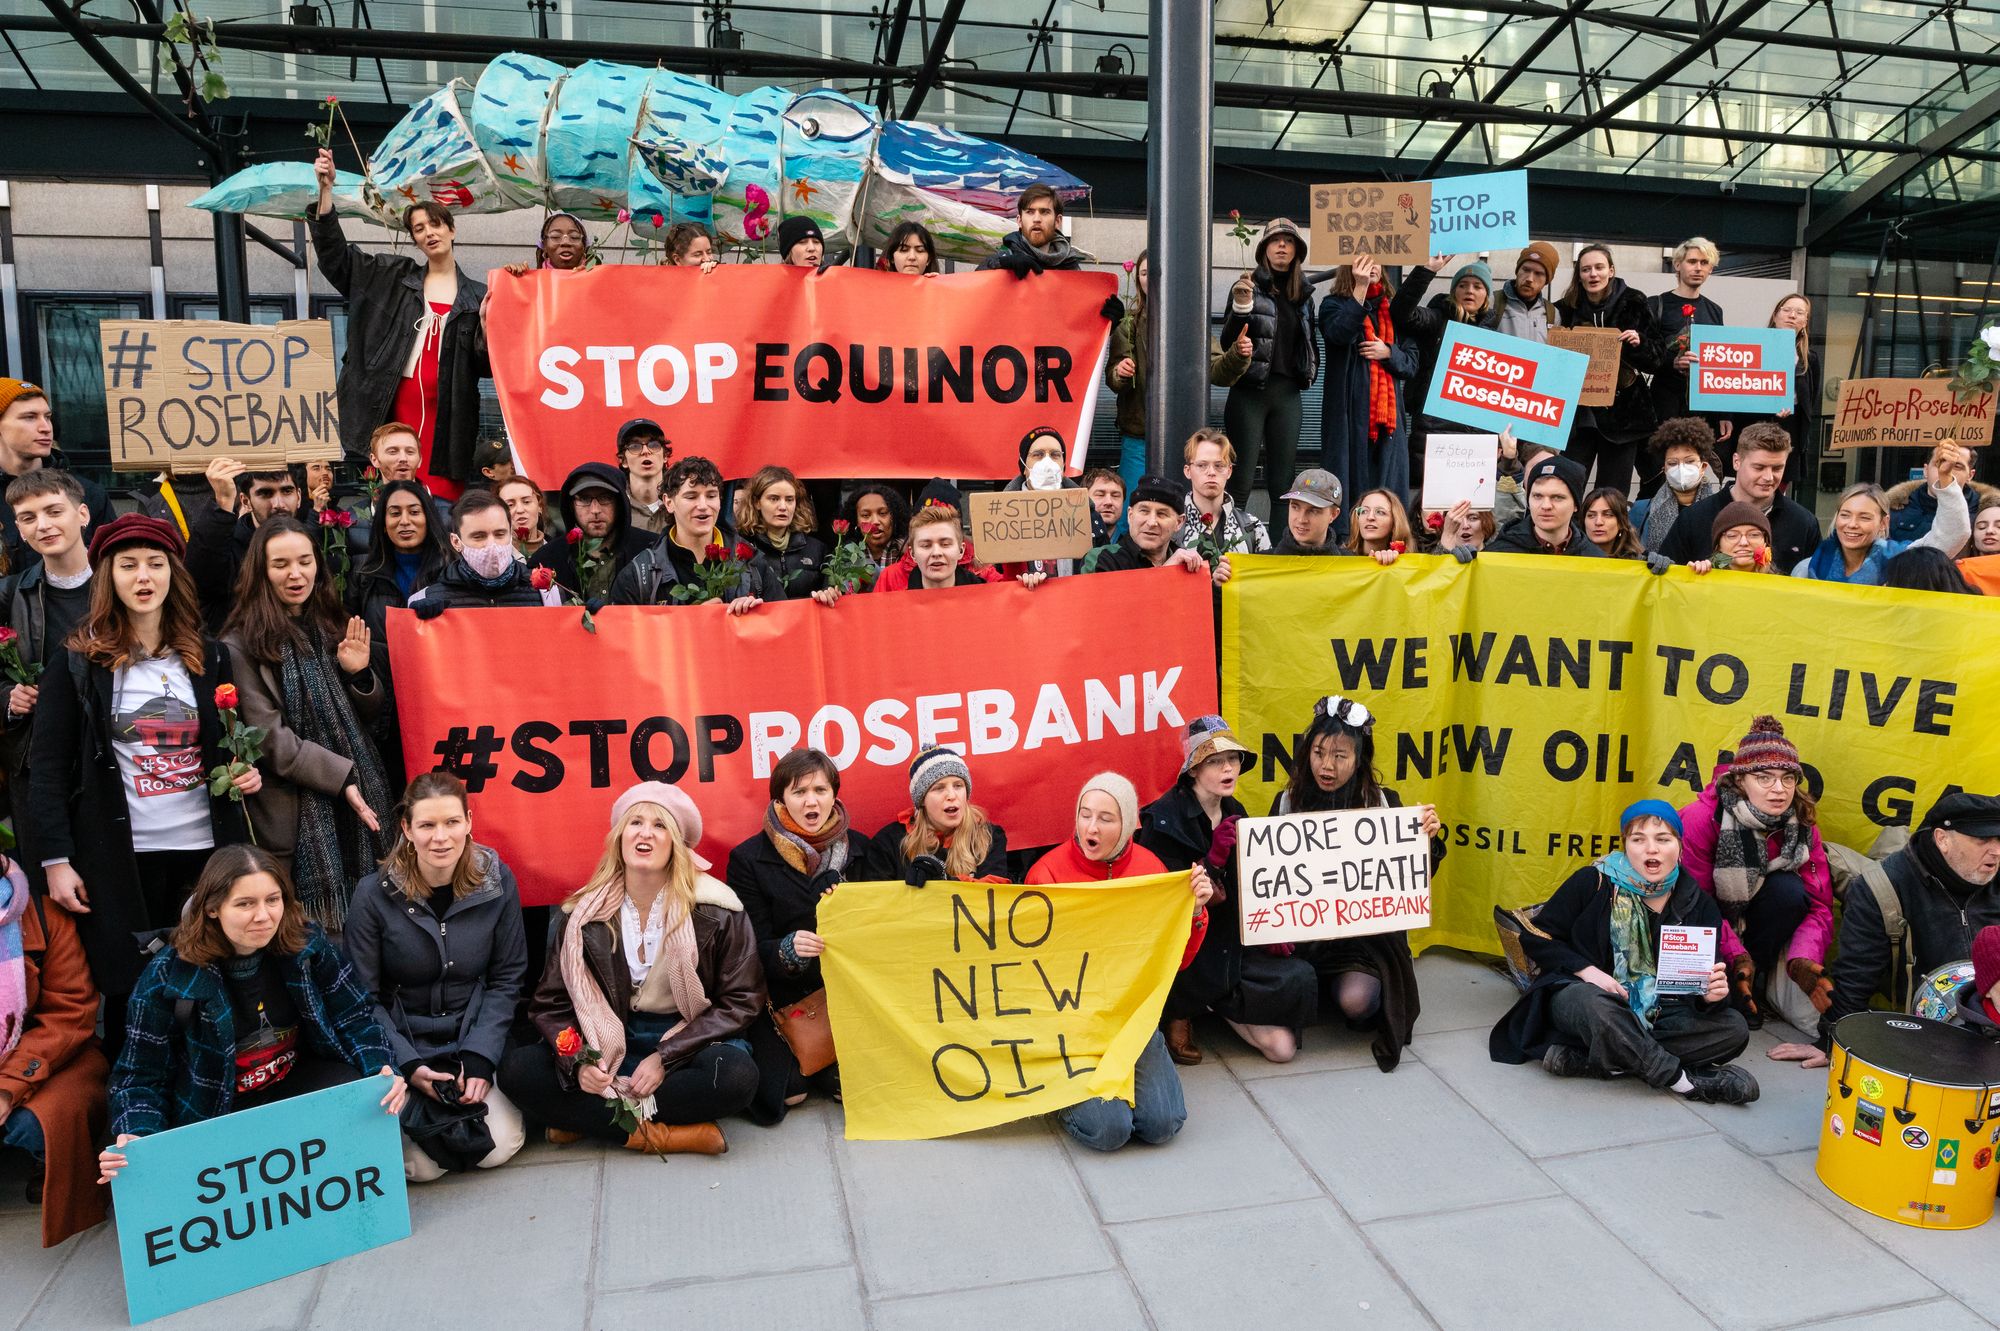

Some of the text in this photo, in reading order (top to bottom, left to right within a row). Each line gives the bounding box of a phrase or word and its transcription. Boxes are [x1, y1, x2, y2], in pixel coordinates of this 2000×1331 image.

[1314, 187, 1384, 209] STOP
[1431, 193, 1490, 214] STOP
[1327, 211, 1394, 232] ROSE
[1430, 210, 1517, 234] QUINOR
[1339, 234, 1413, 255] BANK
[1455, 347, 1525, 383] #Stop
[1703, 345, 1754, 367] #Stop
[538, 342, 1073, 410] STOP EQUINOR
[1703, 371, 1784, 391] Rosebank
[1447, 375, 1560, 421] Rosebank
[119, 391, 341, 459] ROSEBANK
[1833, 427, 1878, 443] EQUINOR'S
[1881, 427, 1921, 442] PROFIT
[1961, 426, 1985, 440] LOSS
[1446, 459, 1487, 469] Rosebank
[988, 498, 1063, 518] #STOP
[982, 518, 1087, 542] ROSEBANK
[1331, 631, 1958, 737] WE WANT TO LIVE
[1395, 724, 1513, 781] NEW
[1542, 729, 1635, 783] OIL
[1246, 817, 1342, 857] MORE
[1252, 863, 1313, 899] GAS
[952, 888, 1054, 953] NO
[1246, 895, 1430, 933] #STOP ROSEBANK
[1663, 934, 1685, 942] #Stop
[1663, 943, 1697, 951] Rosebank
[933, 952, 1089, 1023] NEW
[932, 1034, 1096, 1102] OIL
[196, 1138, 327, 1204] STOP
[144, 1166, 385, 1268] EQUINOR
